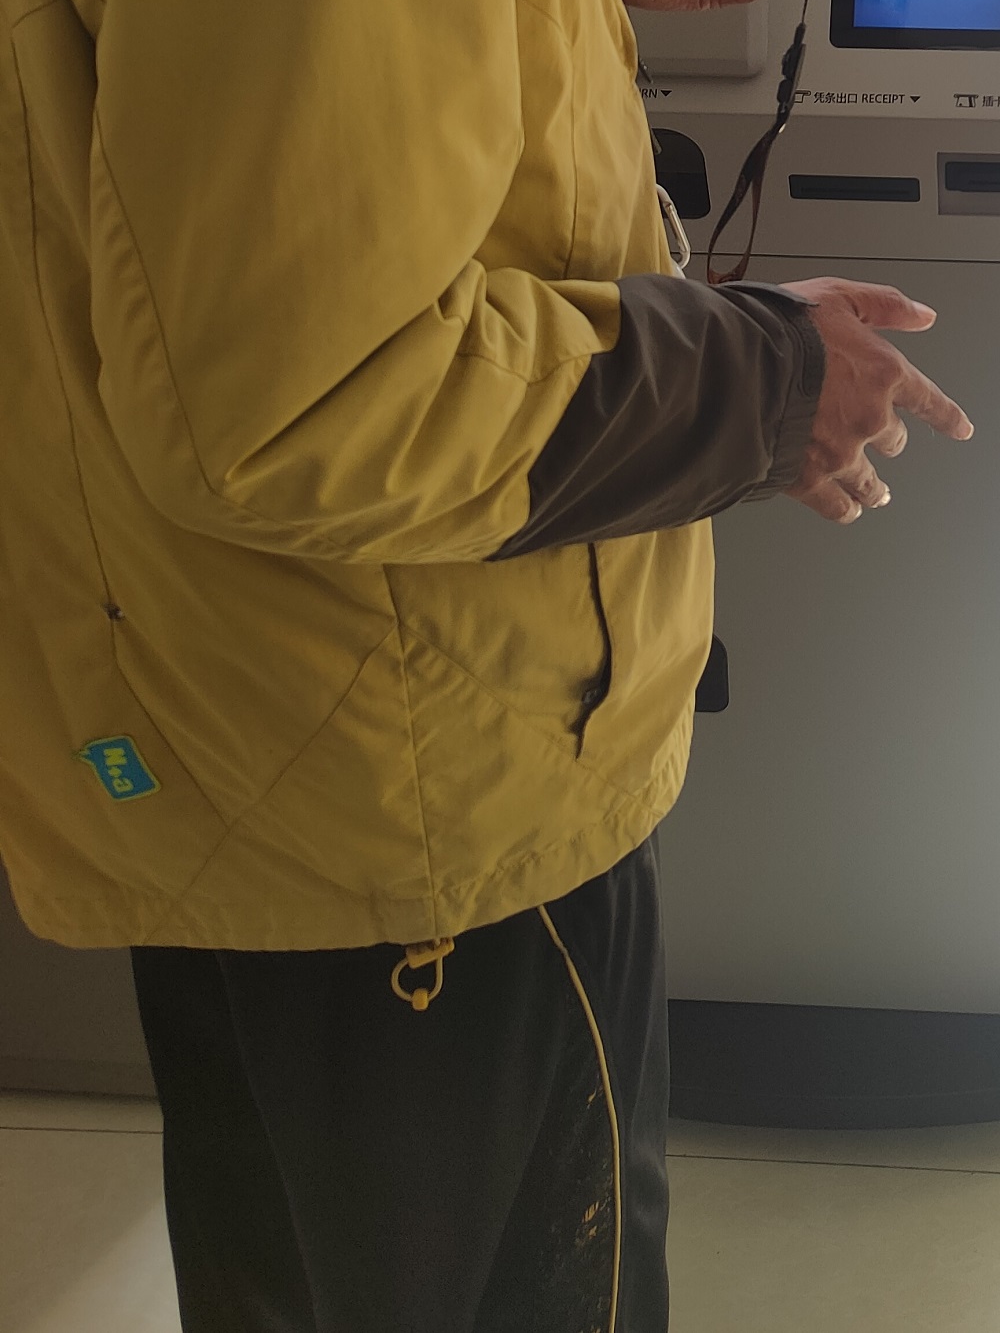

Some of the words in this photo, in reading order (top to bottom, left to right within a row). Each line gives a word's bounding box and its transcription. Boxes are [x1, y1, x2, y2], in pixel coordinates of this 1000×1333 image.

[814, 91, 858, 104] 凭条出口
[861, 94, 905, 104] RECEIPT
